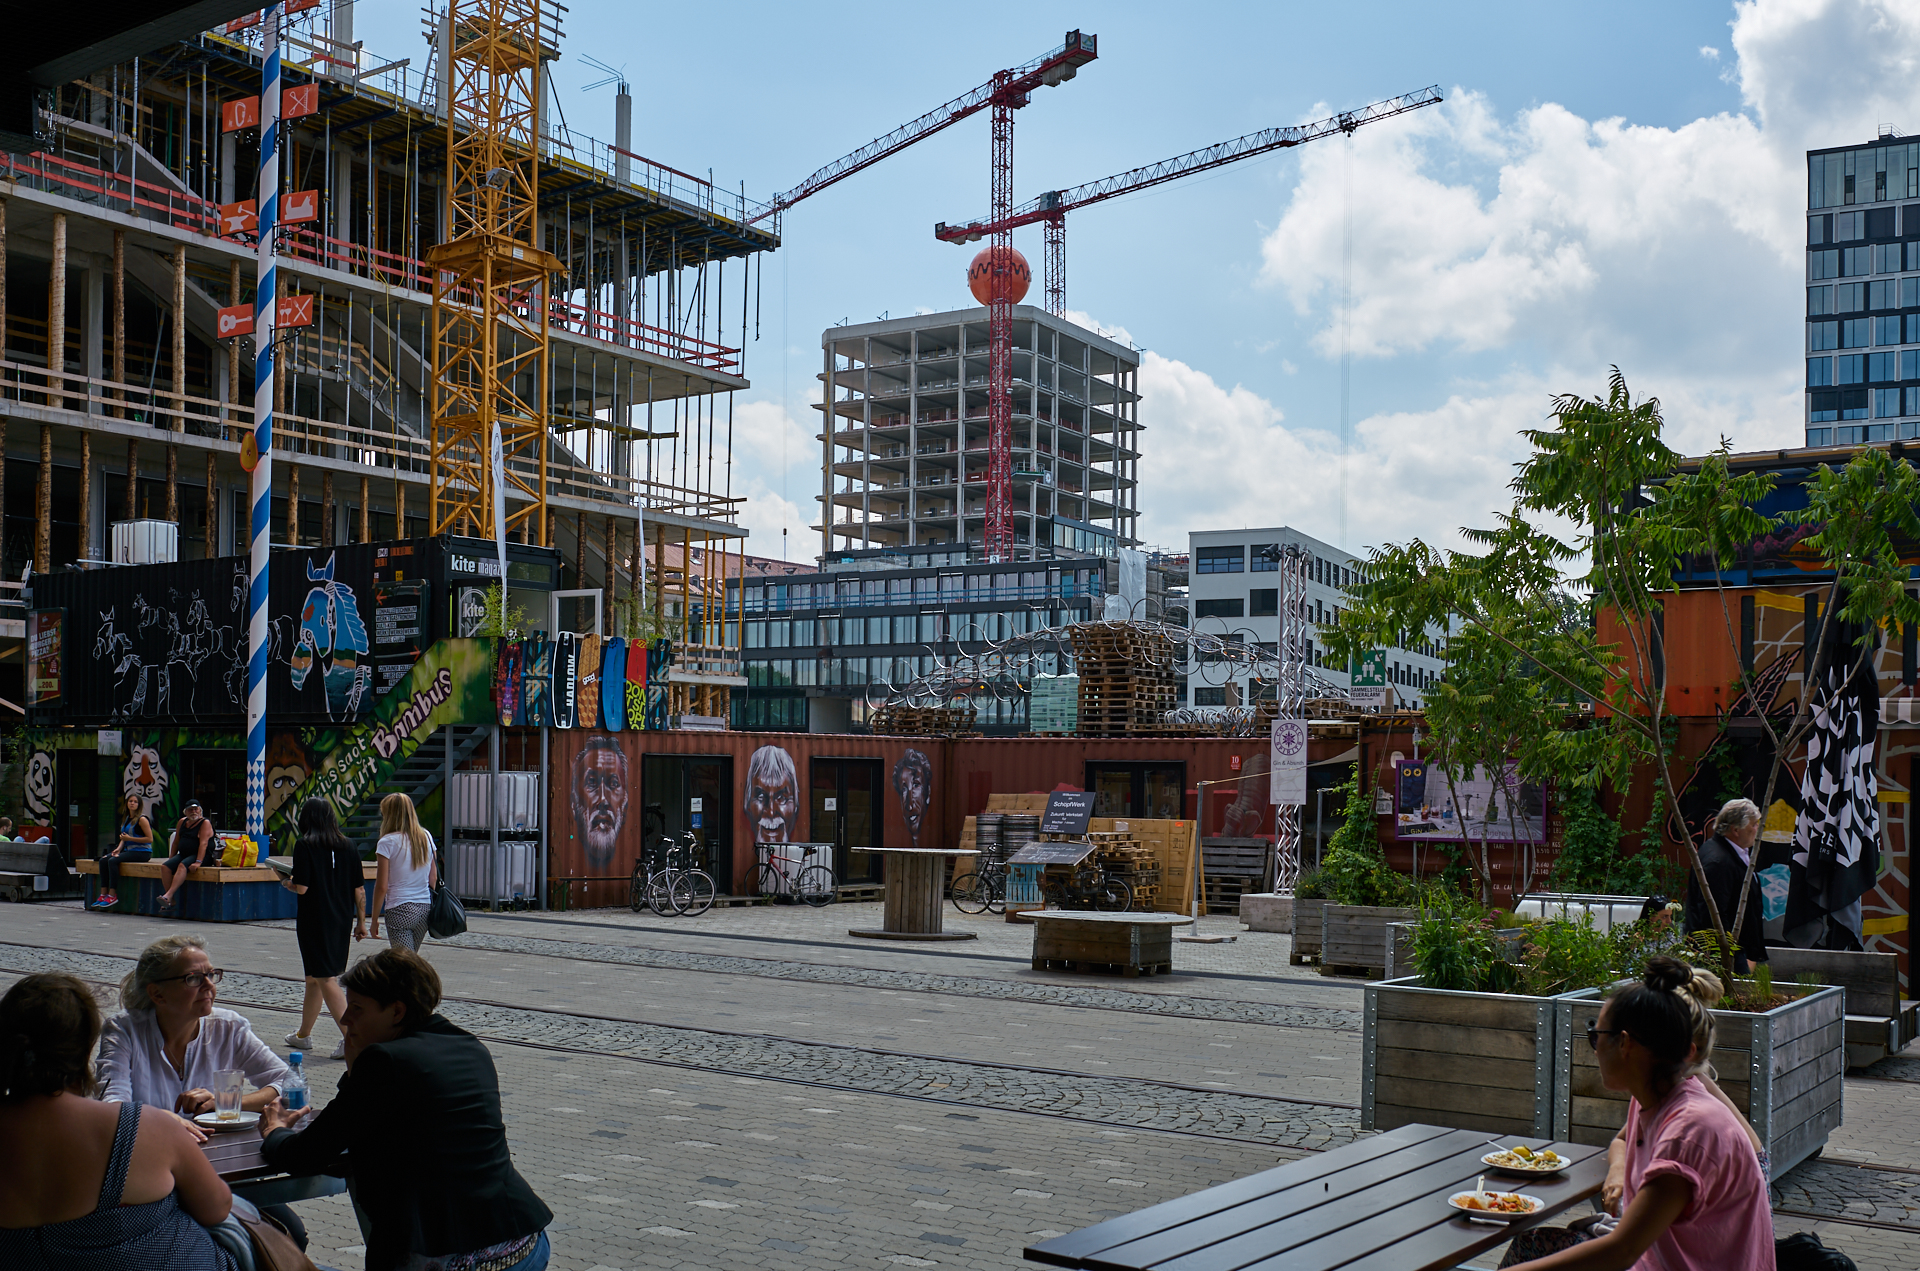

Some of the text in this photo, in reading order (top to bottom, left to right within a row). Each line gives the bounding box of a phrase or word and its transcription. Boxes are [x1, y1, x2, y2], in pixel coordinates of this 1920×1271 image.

[451, 554, 476, 573] kite
[462, 601, 486, 618] kite
[31, 627, 57, 644] DU LIEBST
[31, 638, 52, 651] BURGER
[31, 648, 50, 658] PIZZA?
[370, 667, 453, 759] Bambus
[1276, 723, 1302, 737] COSMIC
[338, 736, 367, 772] sagt
[1275, 741, 1302, 755] SPIRITS
[331, 756, 379, 816] Kauft
